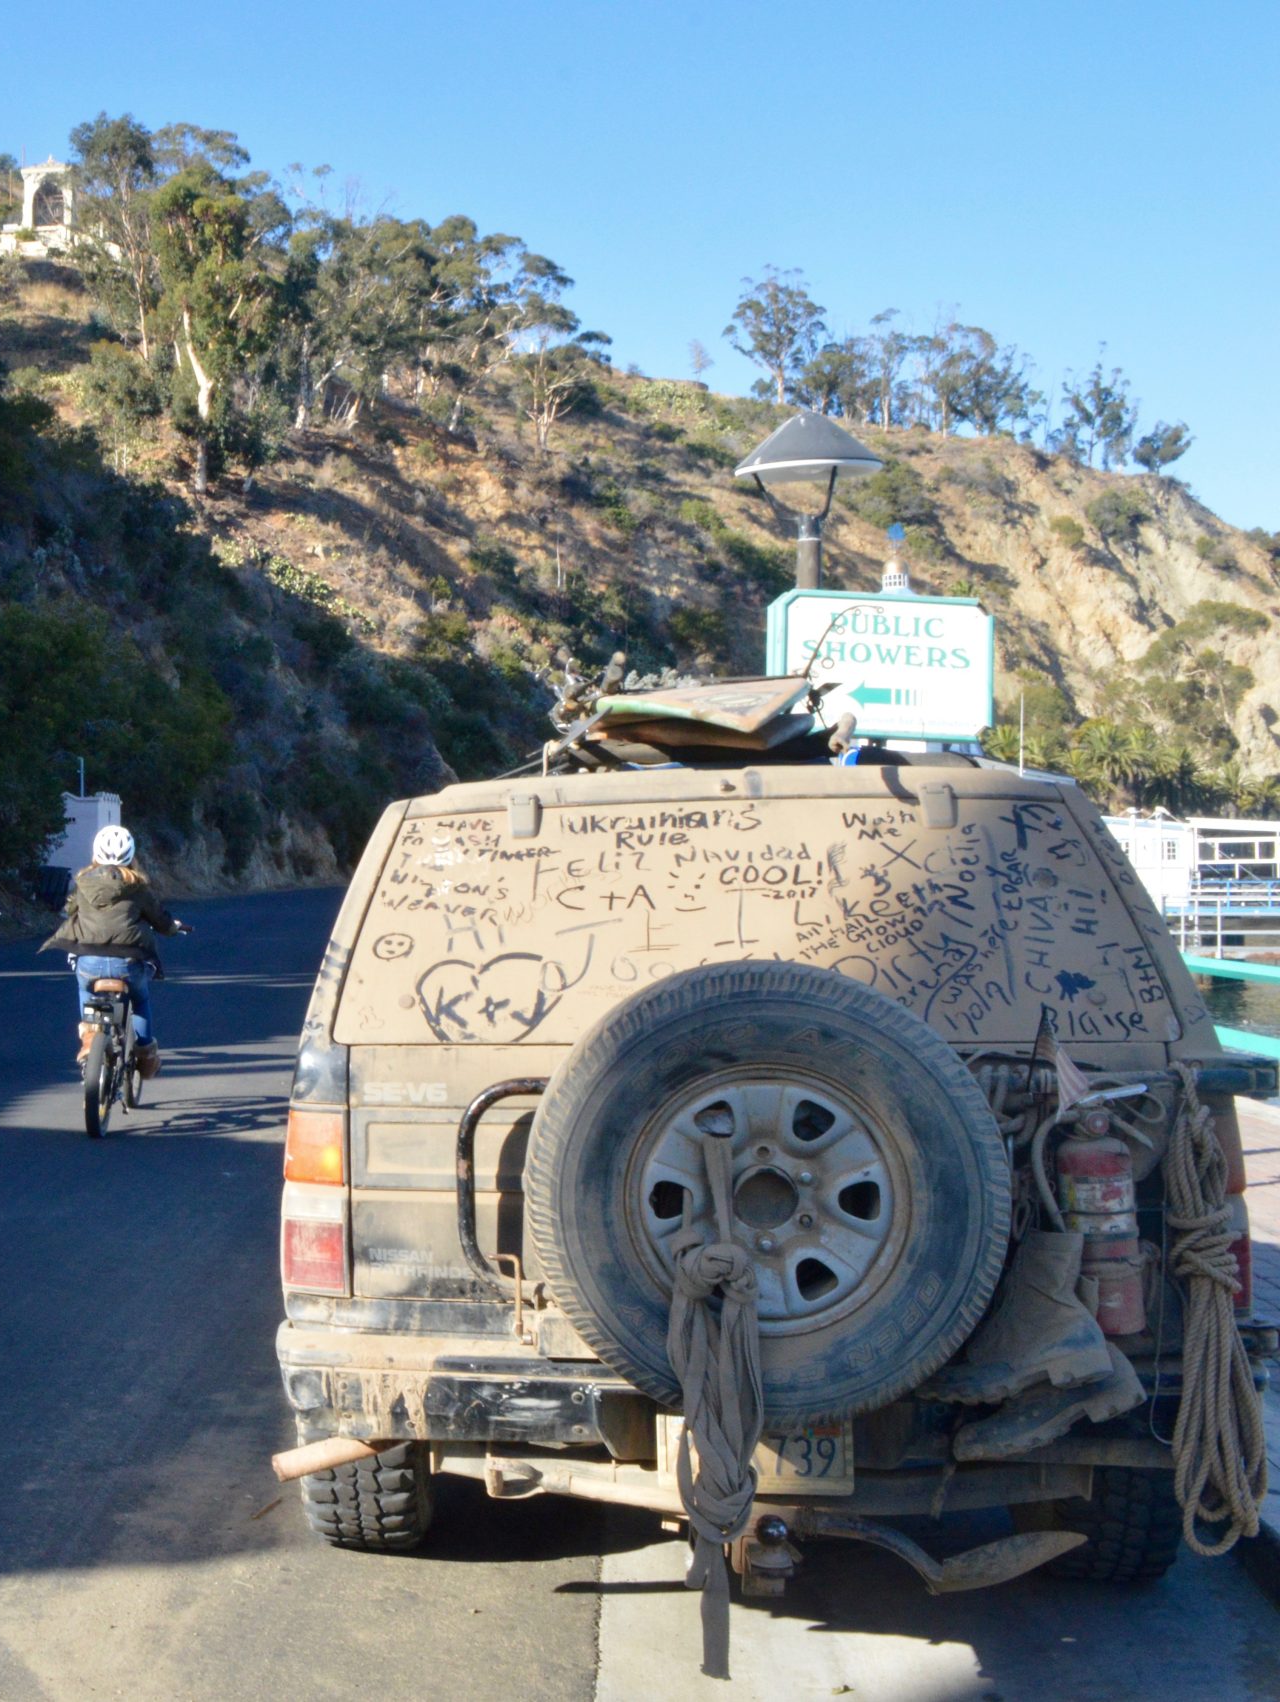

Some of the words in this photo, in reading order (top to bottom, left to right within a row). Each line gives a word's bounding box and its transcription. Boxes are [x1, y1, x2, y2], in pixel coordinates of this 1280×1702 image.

[830, 611, 945, 639] PUBLIC
[802, 639, 971, 670] SHOWERS
[719, 861, 823, 886] COOL!
[368, 1247, 433, 1264] NISSAN
[369, 1262, 477, 1279] PATHFINDE
[751, 1434, 837, 1479] 739
